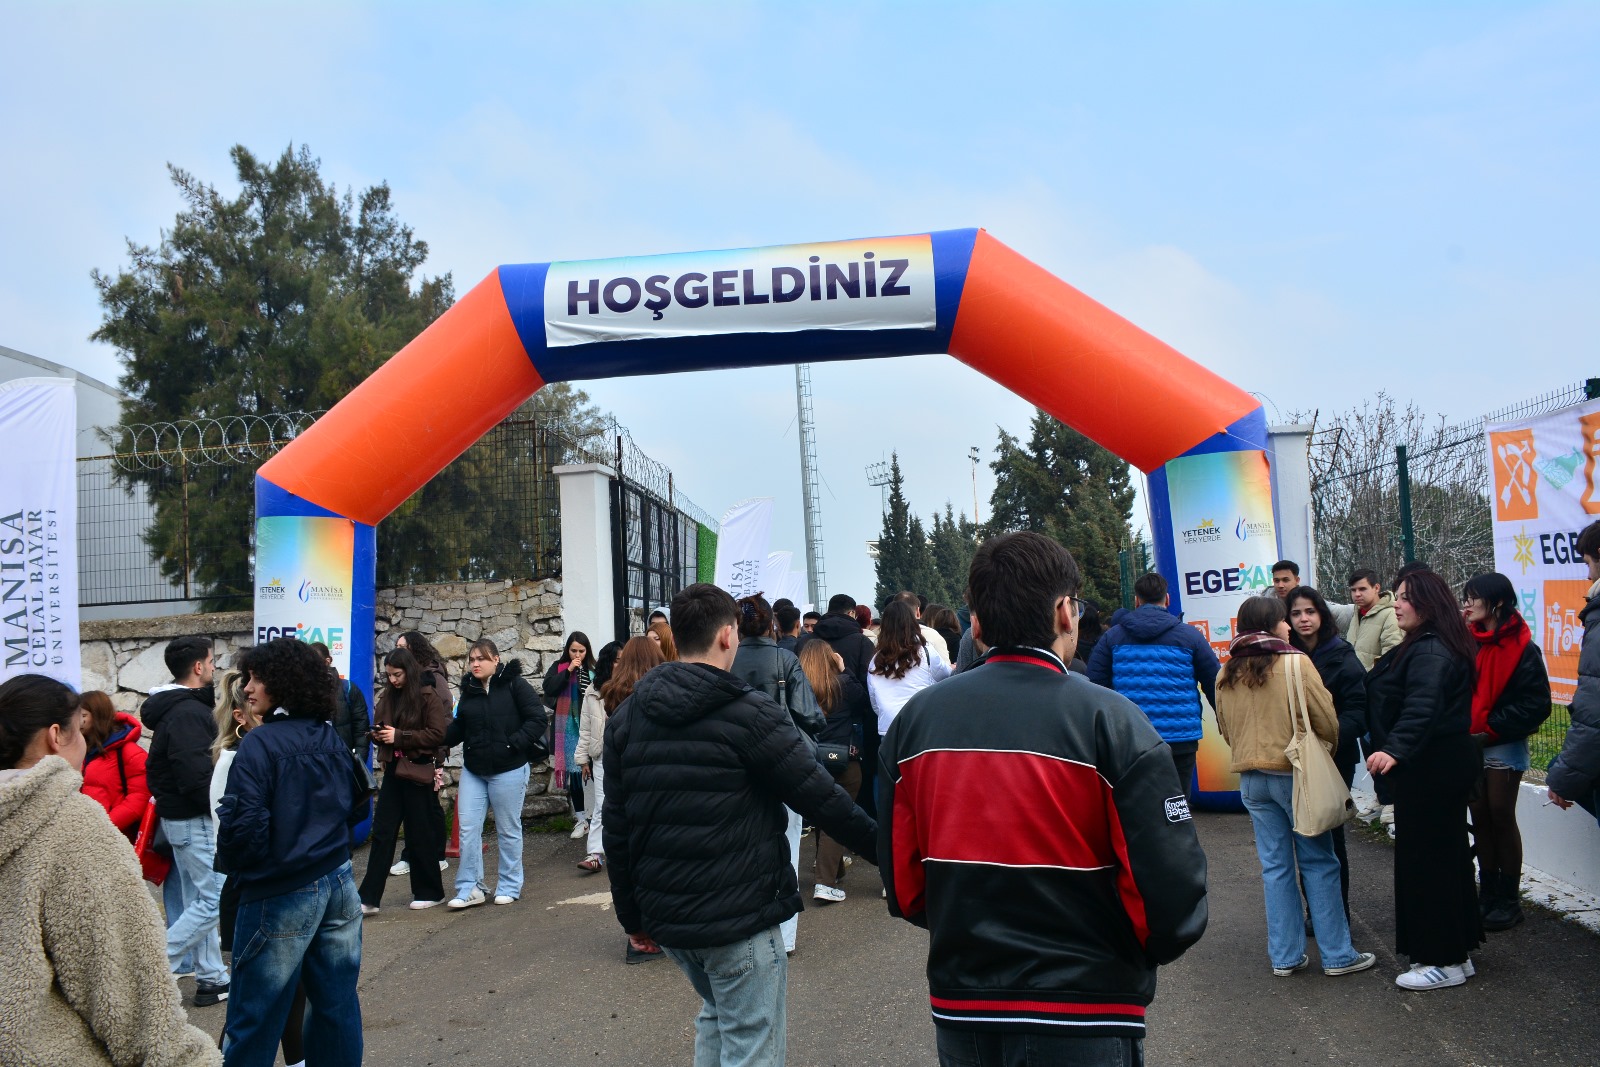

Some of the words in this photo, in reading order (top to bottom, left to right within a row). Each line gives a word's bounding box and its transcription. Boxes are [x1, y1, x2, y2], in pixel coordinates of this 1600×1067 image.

[567, 251, 911, 321] HOŞGELDİNİZ
[28, 509, 43, 583] BAYAR
[1182, 527, 1221, 538] YETENEK
[46, 509, 63, 665] ÜNİVERSİTESİ
[260, 586, 286, 594] YETENEK
[32, 590, 47, 667] CELAL
